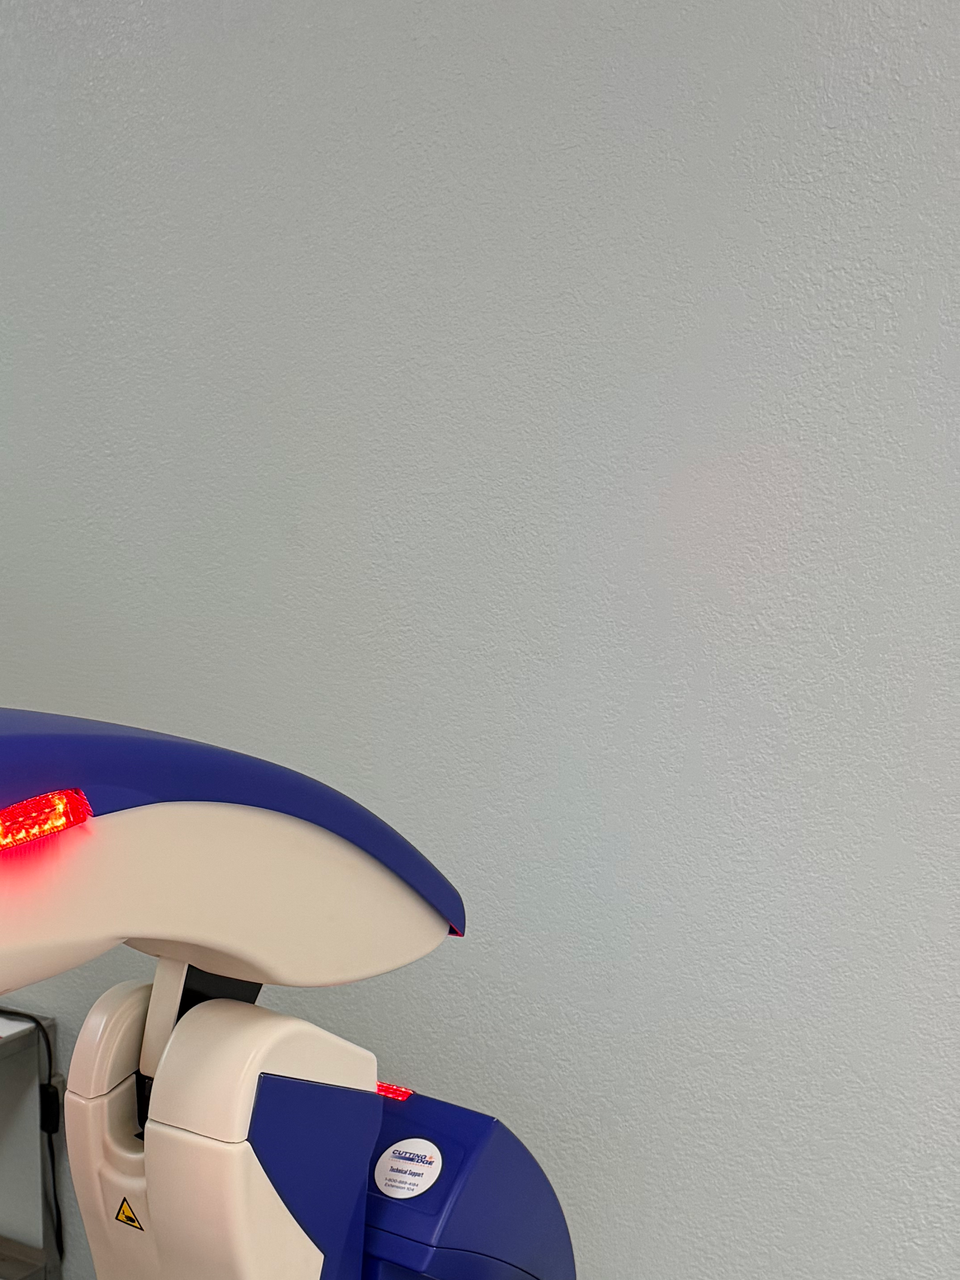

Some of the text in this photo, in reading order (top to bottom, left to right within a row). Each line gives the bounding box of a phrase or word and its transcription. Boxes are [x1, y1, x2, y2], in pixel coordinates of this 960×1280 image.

[392, 1150, 427, 1160] CUTTING
[413, 1158, 434, 1166] EDGE
[389, 1166, 424, 1178] Technical Support
[384, 1182, 406, 1190] Extension
